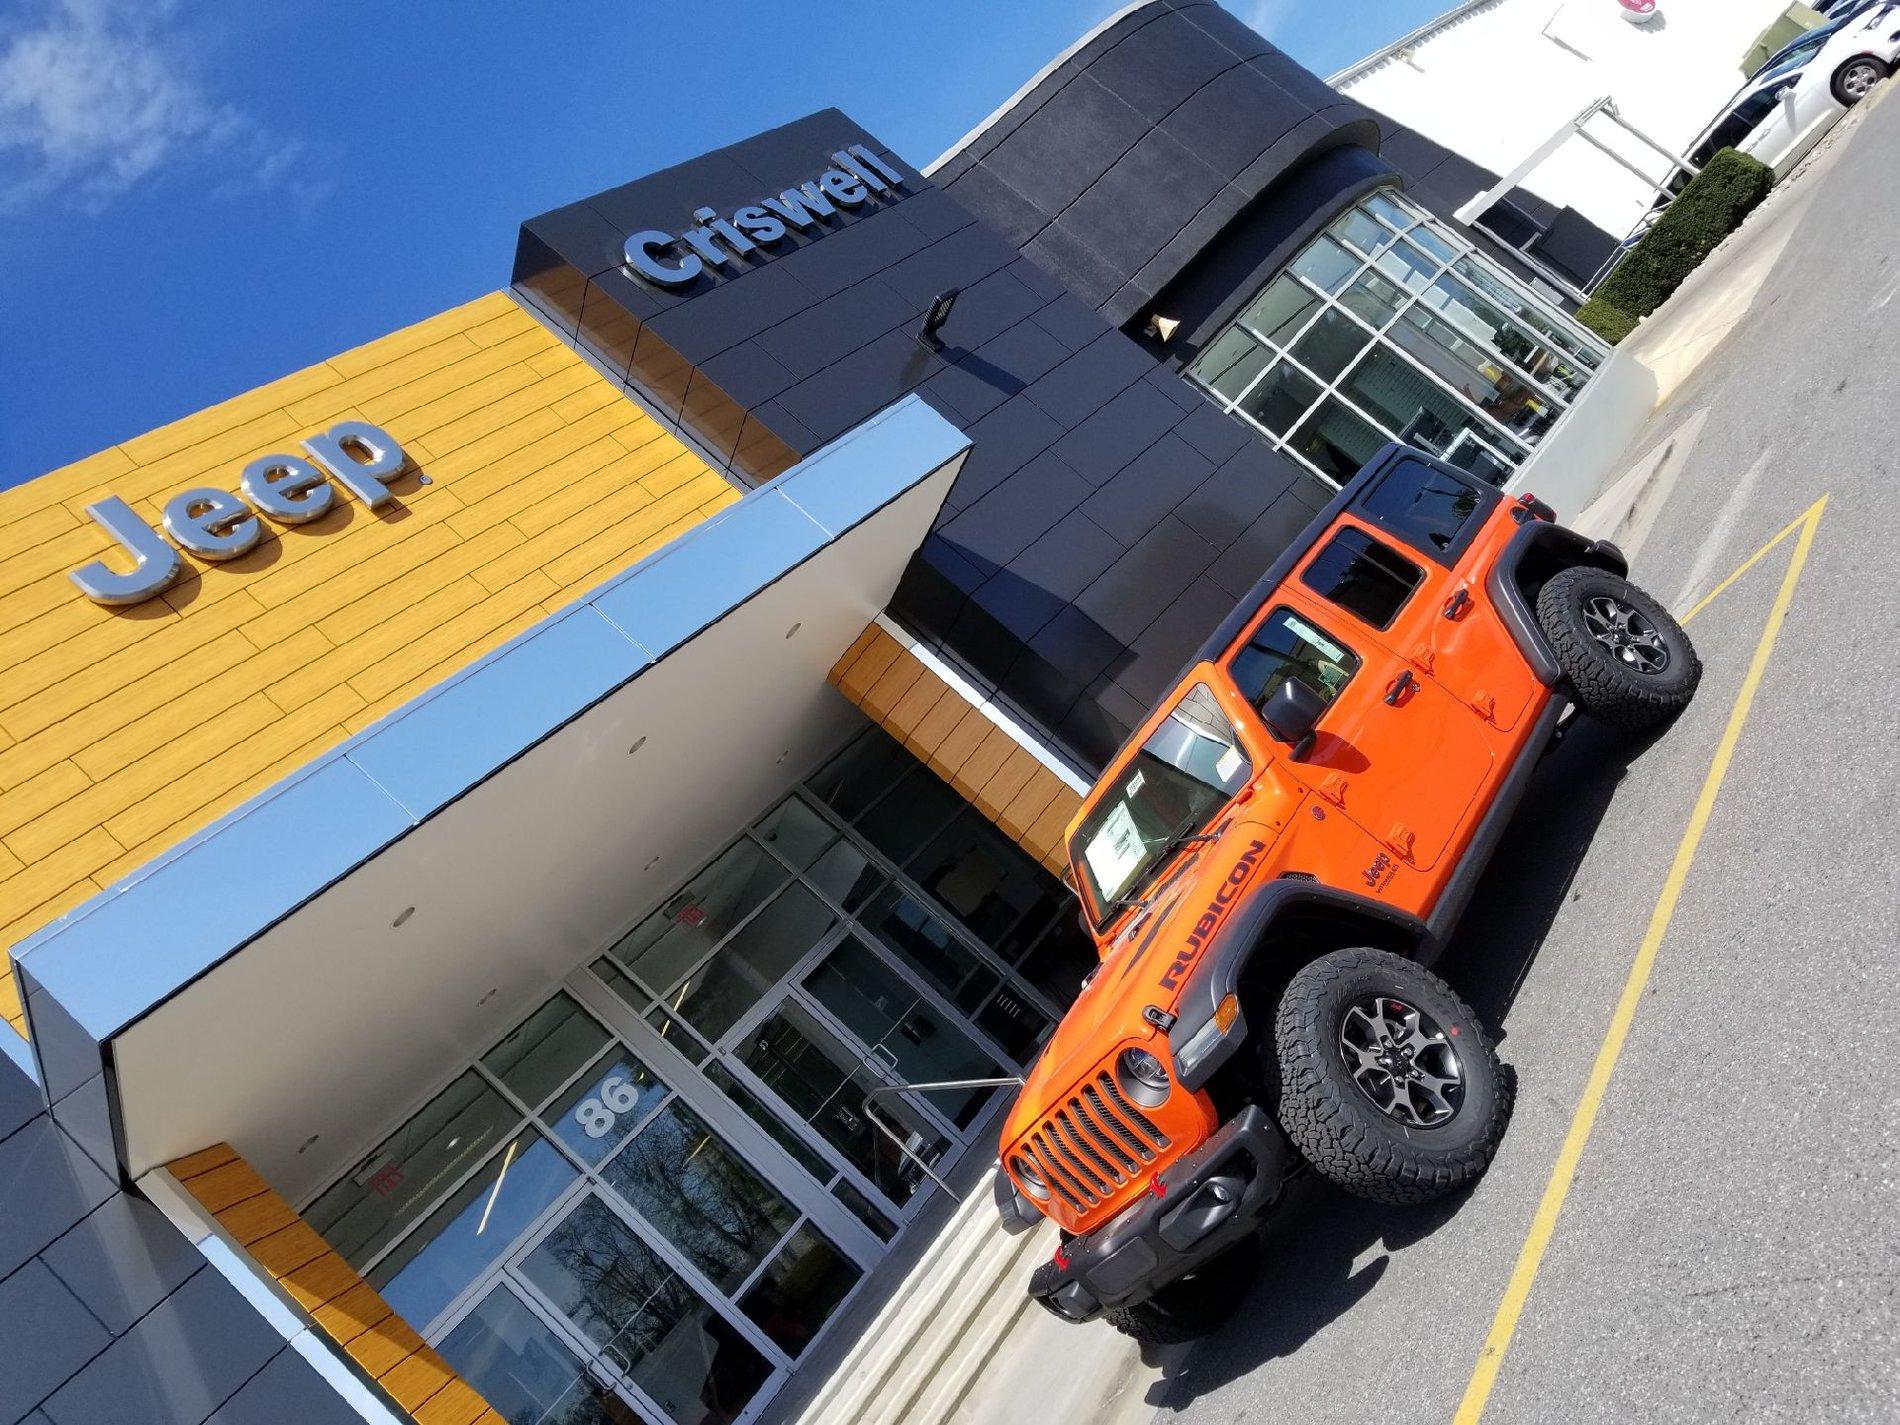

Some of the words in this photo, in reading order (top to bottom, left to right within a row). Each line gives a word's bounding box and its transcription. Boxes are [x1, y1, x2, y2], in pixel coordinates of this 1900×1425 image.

[623, 143, 905, 286] Criswell
[67, 420, 406, 606] Jeep
[1159, 839, 1267, 991] RUBICON
[1361, 852, 1391, 887] Jeep
[575, 1076, 639, 1138] 86
